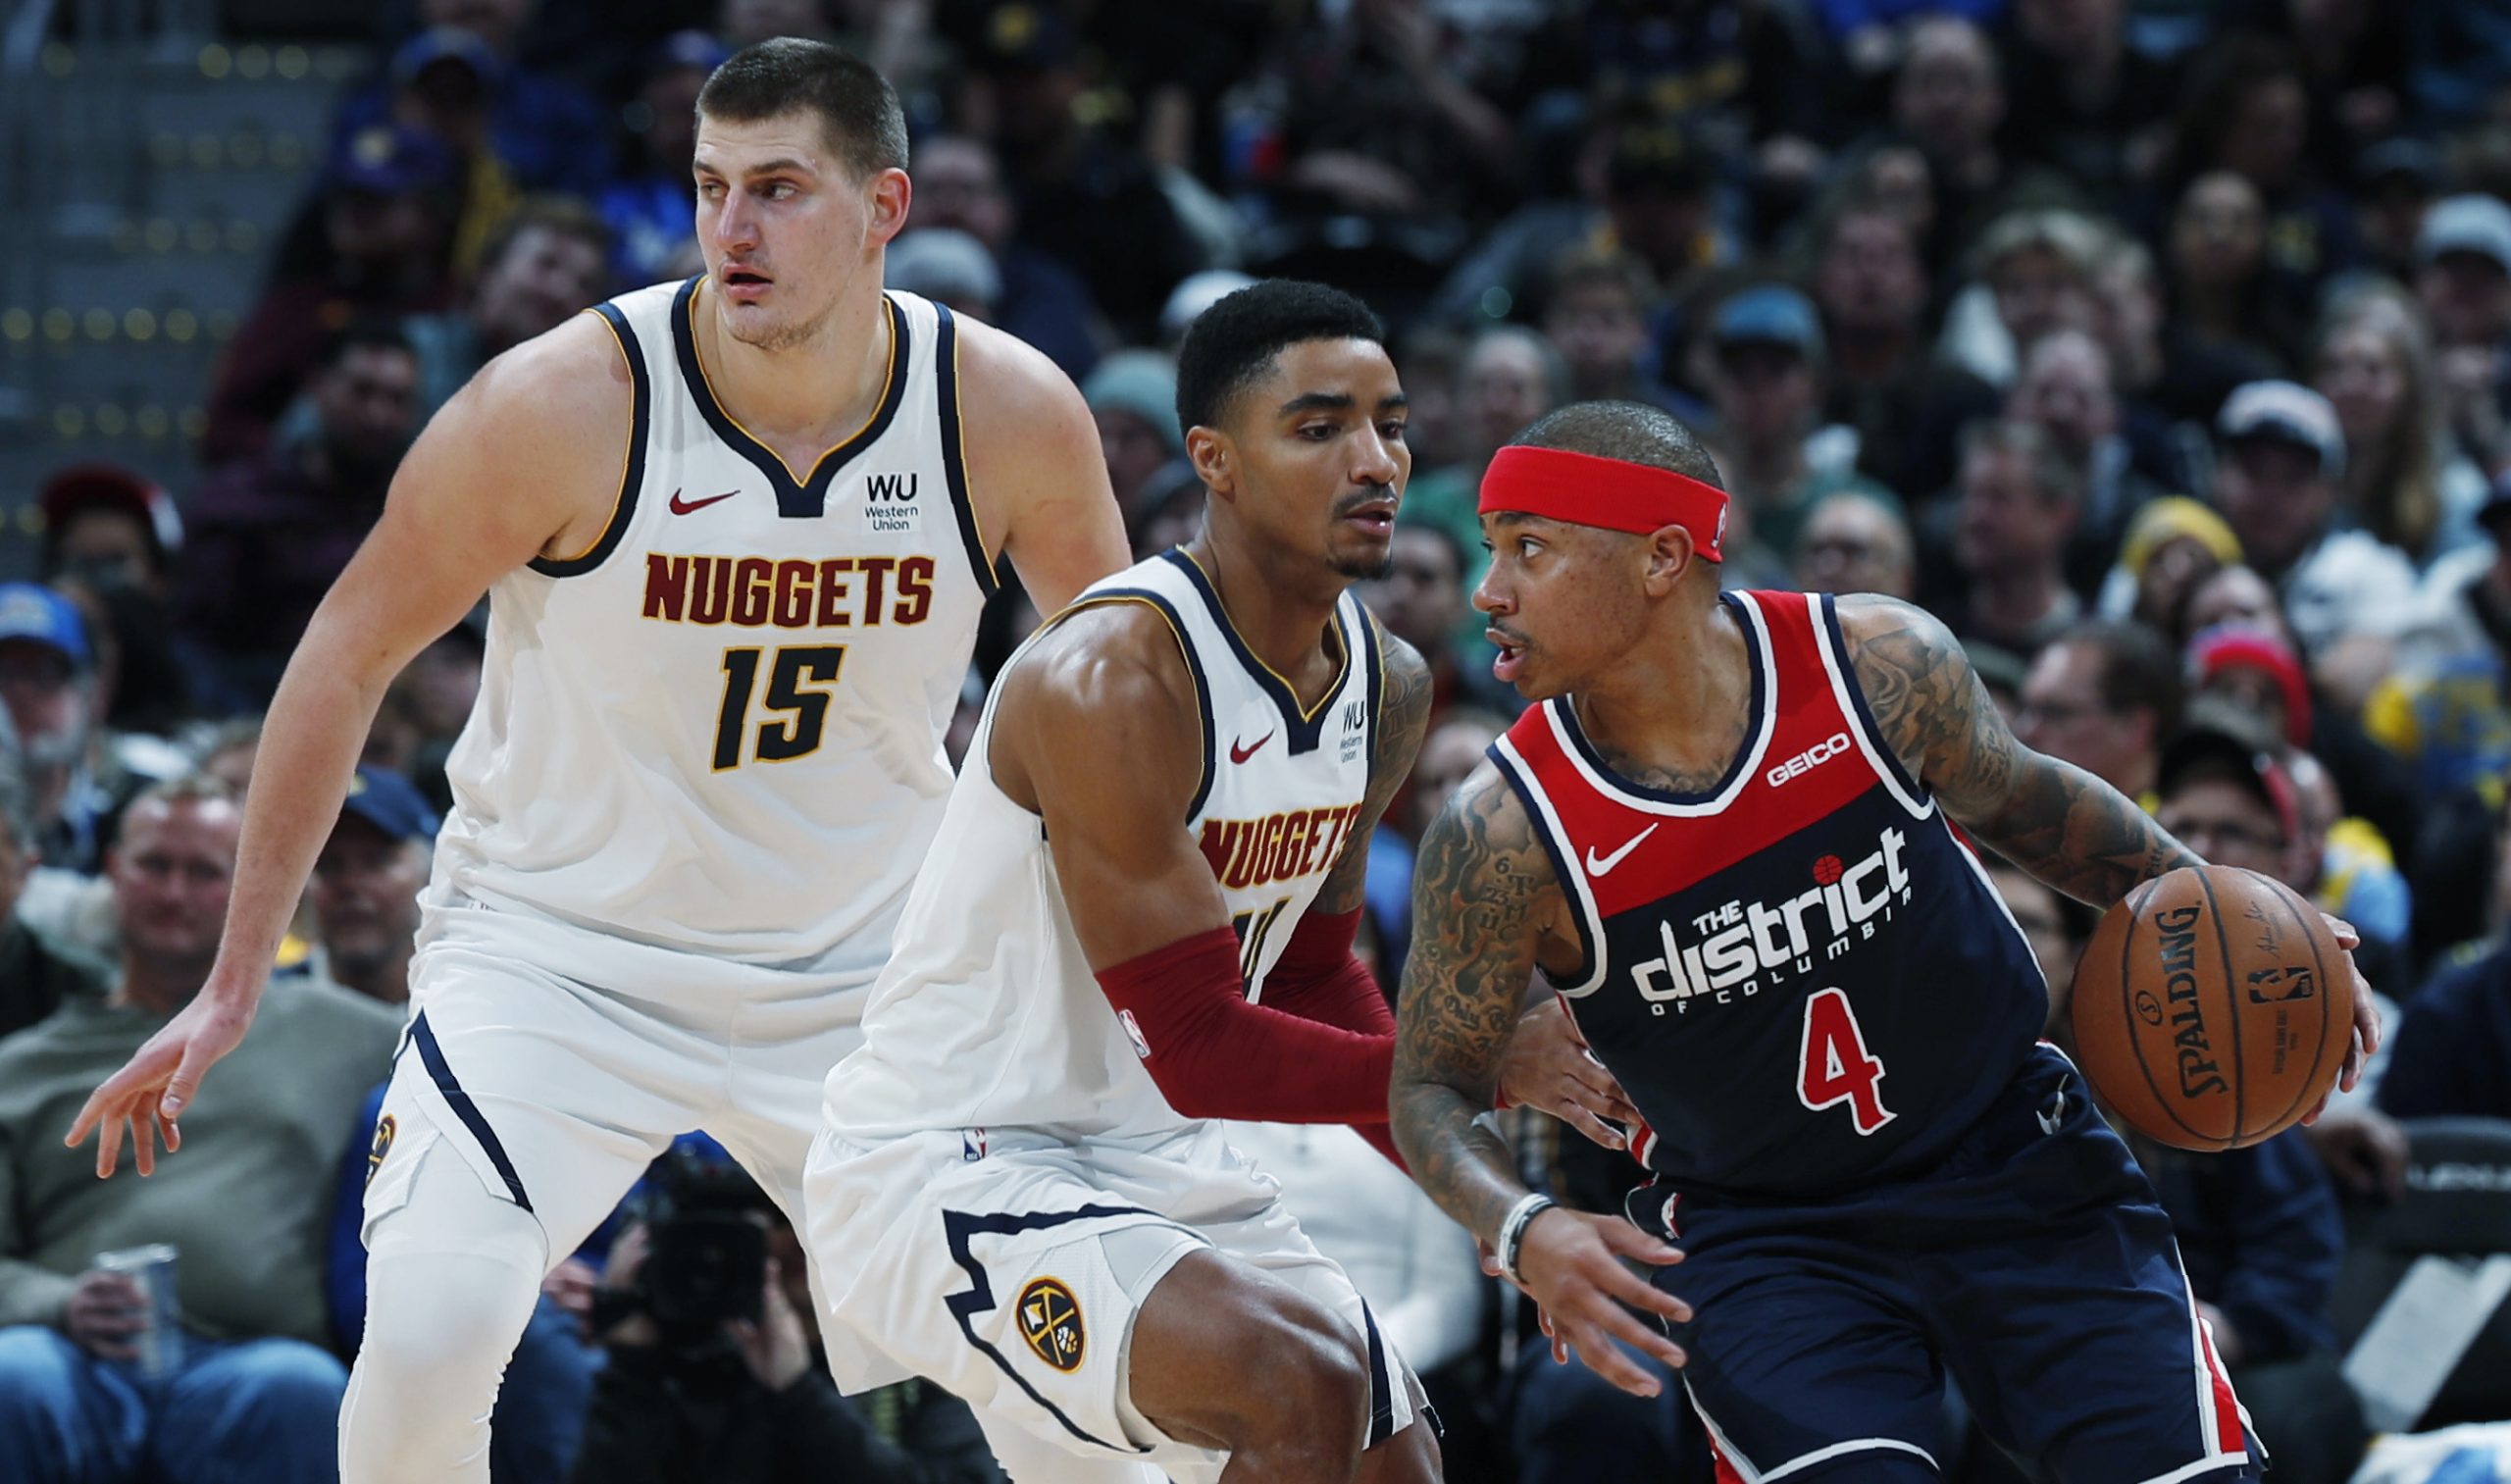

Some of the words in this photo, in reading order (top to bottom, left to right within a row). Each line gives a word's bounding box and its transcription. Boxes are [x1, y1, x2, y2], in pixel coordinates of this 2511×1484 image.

[864, 506, 919, 518] Western
[866, 473, 917, 502] WU
[873, 517, 910, 531] Union
[641, 550, 936, 629] NUGGETS
[710, 643, 849, 774] 15
[1343, 700, 1364, 734] WU
[1766, 732, 1852, 788] GEICO
[1629, 826, 1910, 1003] district
[1692, 899, 1744, 936] THE
[1651, 1000, 1688, 1017] OF
[1716, 885, 1913, 1005] COLUMBIA
[2154, 903, 2229, 1100] SPALDING
[1797, 986, 1899, 1136] 4
